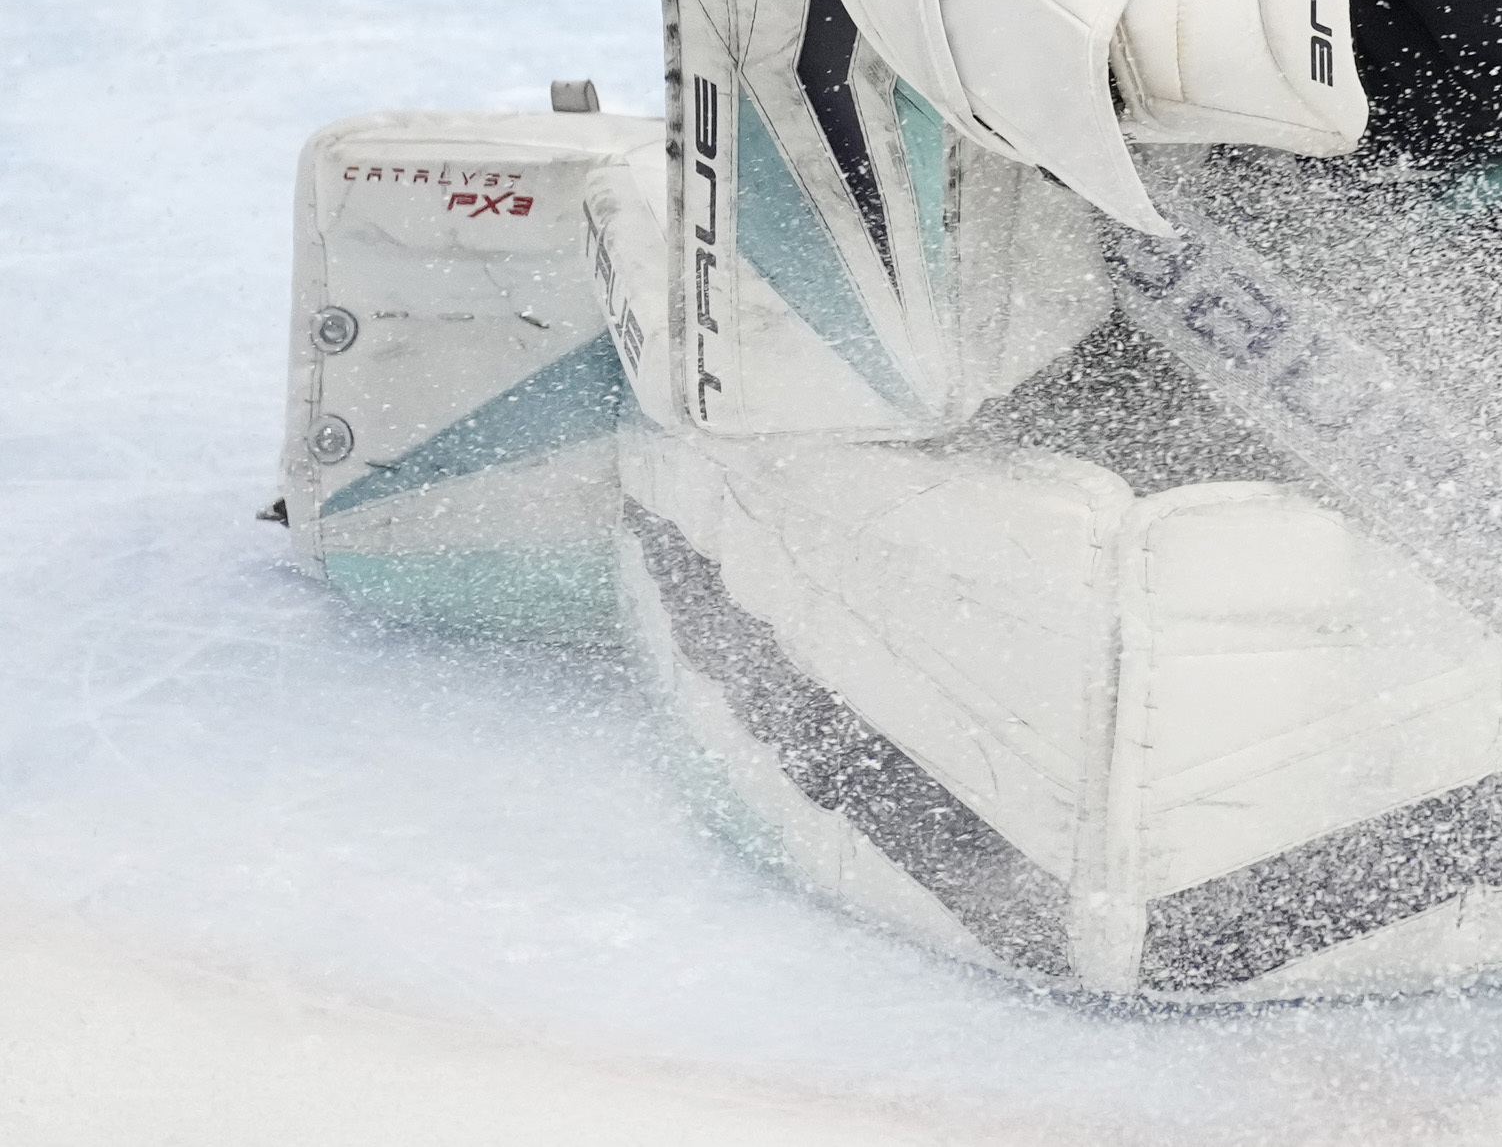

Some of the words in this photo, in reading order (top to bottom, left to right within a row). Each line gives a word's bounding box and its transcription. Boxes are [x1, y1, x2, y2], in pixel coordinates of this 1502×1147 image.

[344, 166, 521, 189] CATALYST
[447, 191, 534, 218] PX3
[694, 73, 722, 422] TRUE
